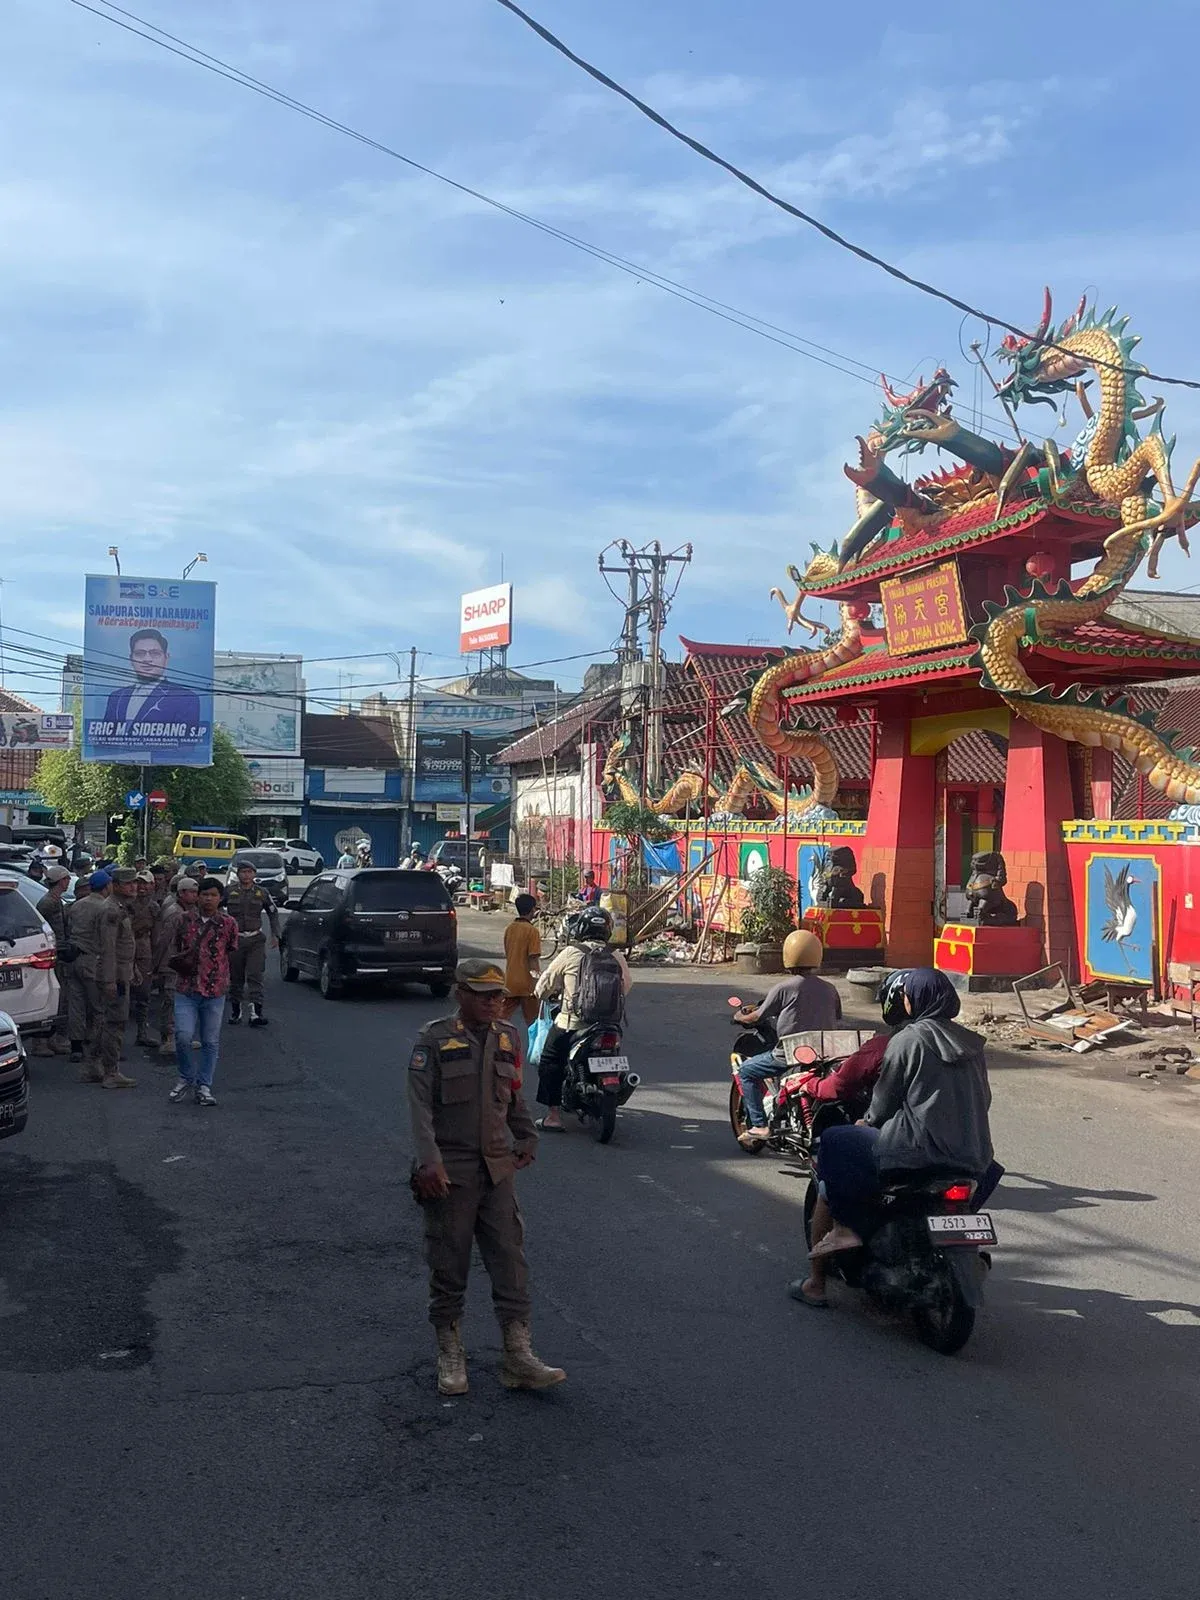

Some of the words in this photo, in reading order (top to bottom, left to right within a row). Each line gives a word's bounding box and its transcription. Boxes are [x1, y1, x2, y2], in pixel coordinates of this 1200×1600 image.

[88, 604, 153, 618] SAMPURASUN
[155, 607, 209, 619] KARAWANG
[464, 598, 506, 621] SHARP
[46, 717, 53, 728] 5
[88, 721, 114, 735] ERIC
[115, 722, 129, 736] M.
[132, 723, 187, 737] SIDEBANG
[930, 1219, 935, 1229] T
[942, 1217, 966, 1229] 2573
